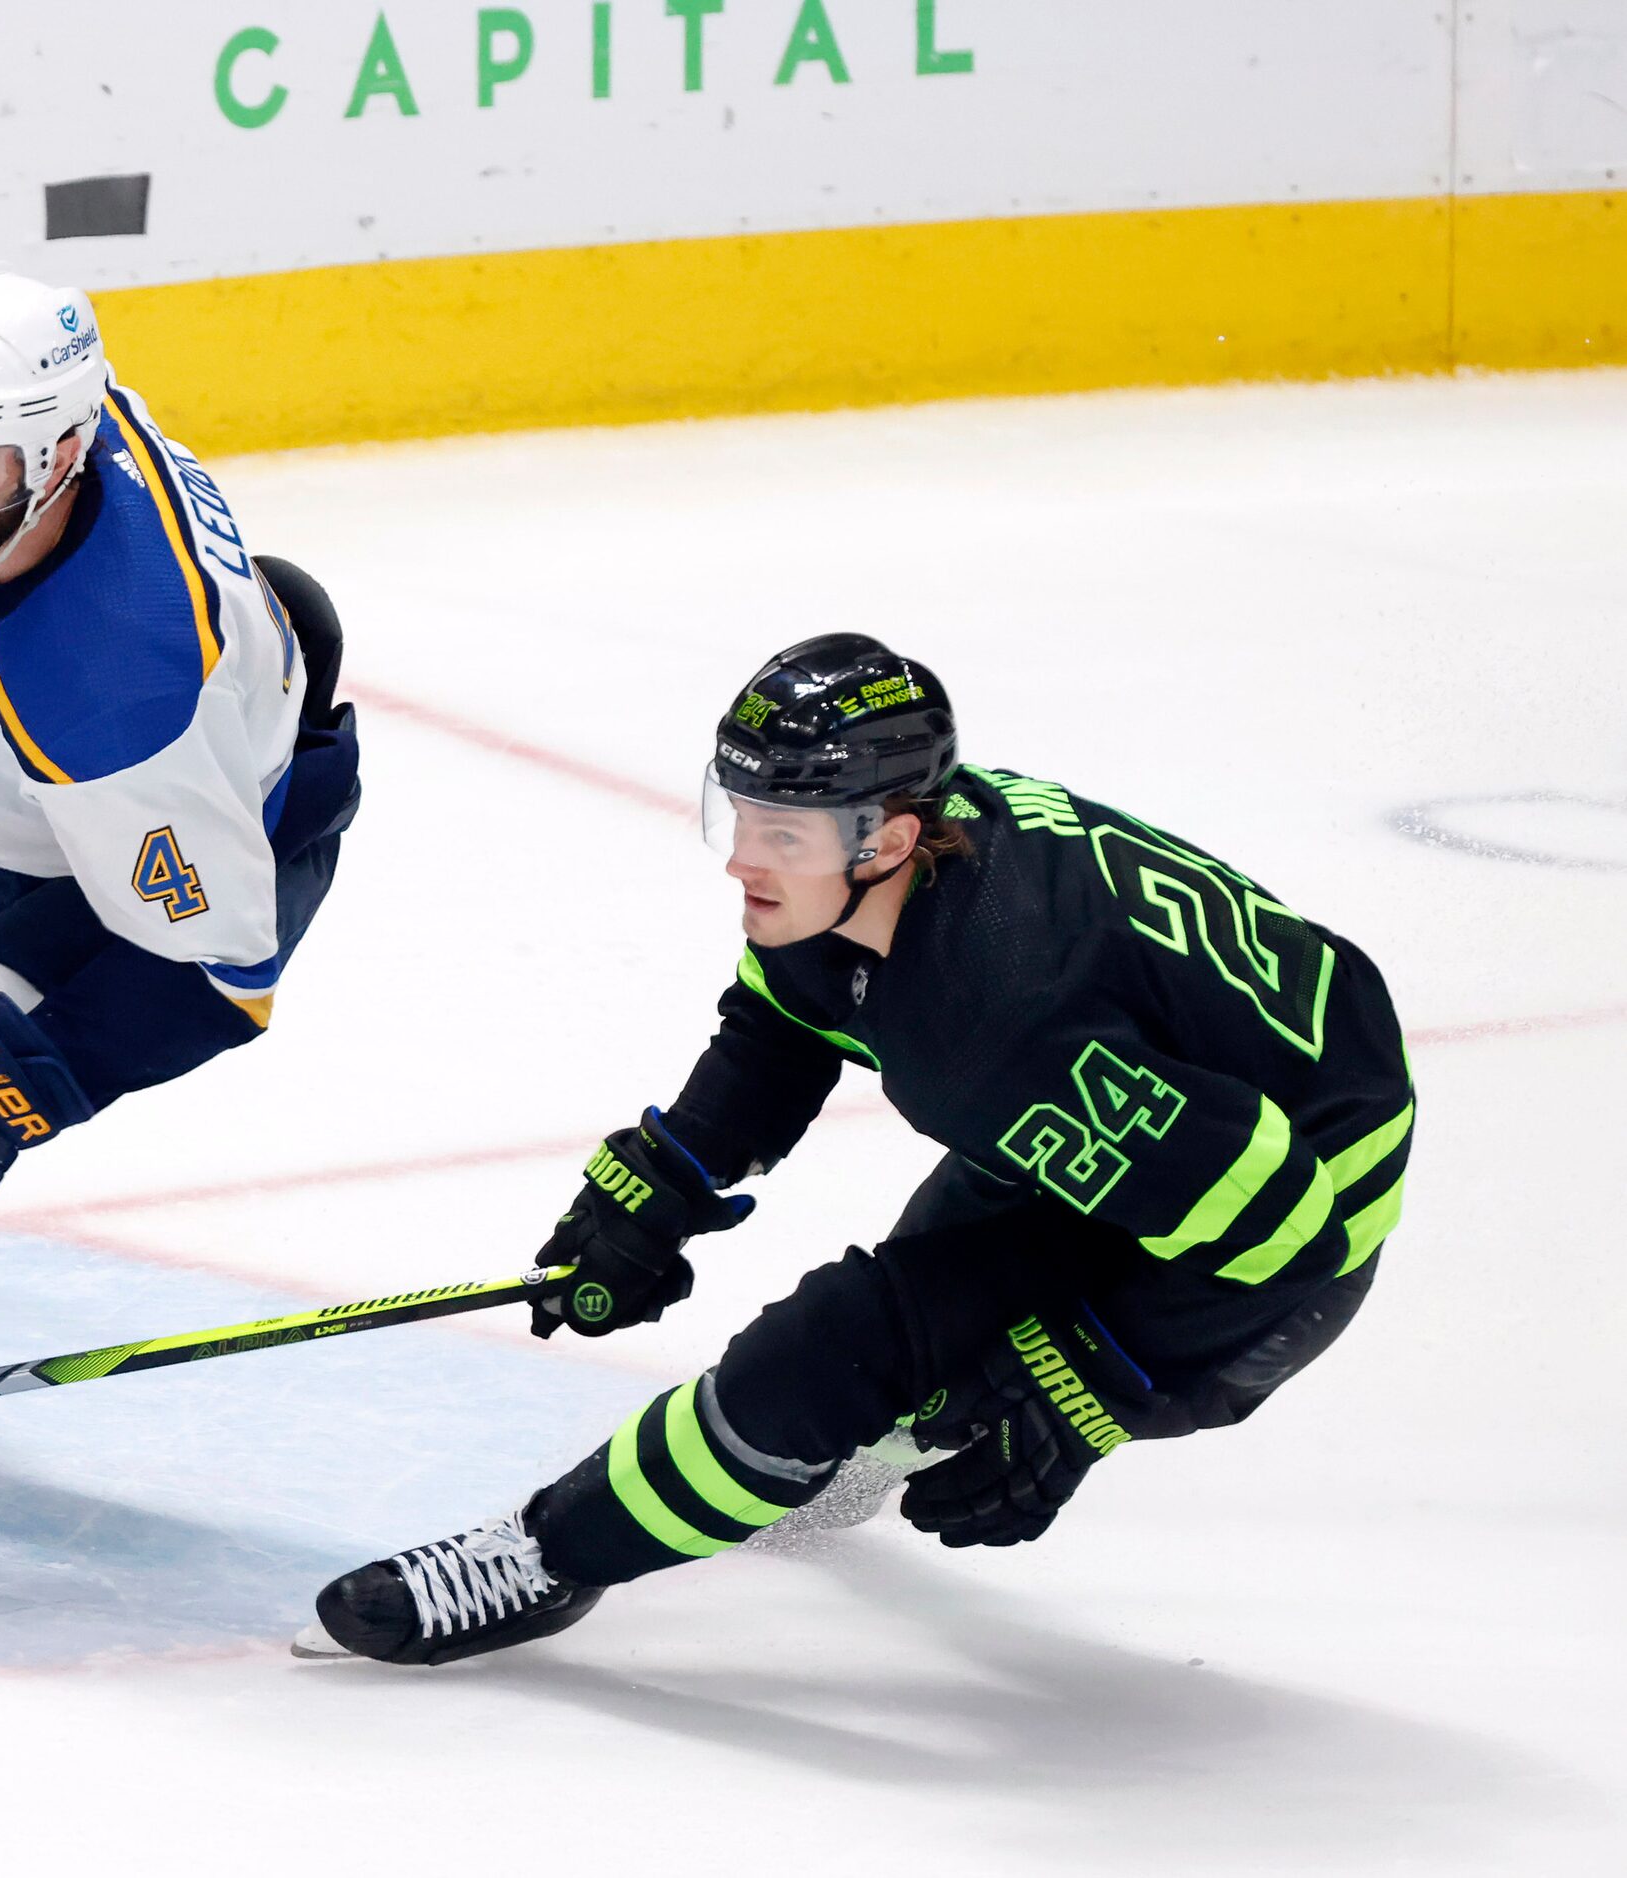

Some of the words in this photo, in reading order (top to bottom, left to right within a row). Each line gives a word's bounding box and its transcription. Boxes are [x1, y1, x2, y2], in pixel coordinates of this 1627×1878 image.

[214, 0, 975, 129] CAPITAL
[51, 326, 98, 366] CarShield
[859, 674, 908, 699] ENERGY
[866, 685, 926, 712] TRANSFER
[733, 692, 777, 730] 24
[719, 743, 763, 772] CCM
[131, 825, 210, 923] 4
[996, 1039, 1188, 1216] 24
[190, 1325, 309, 1361] ALPHA
